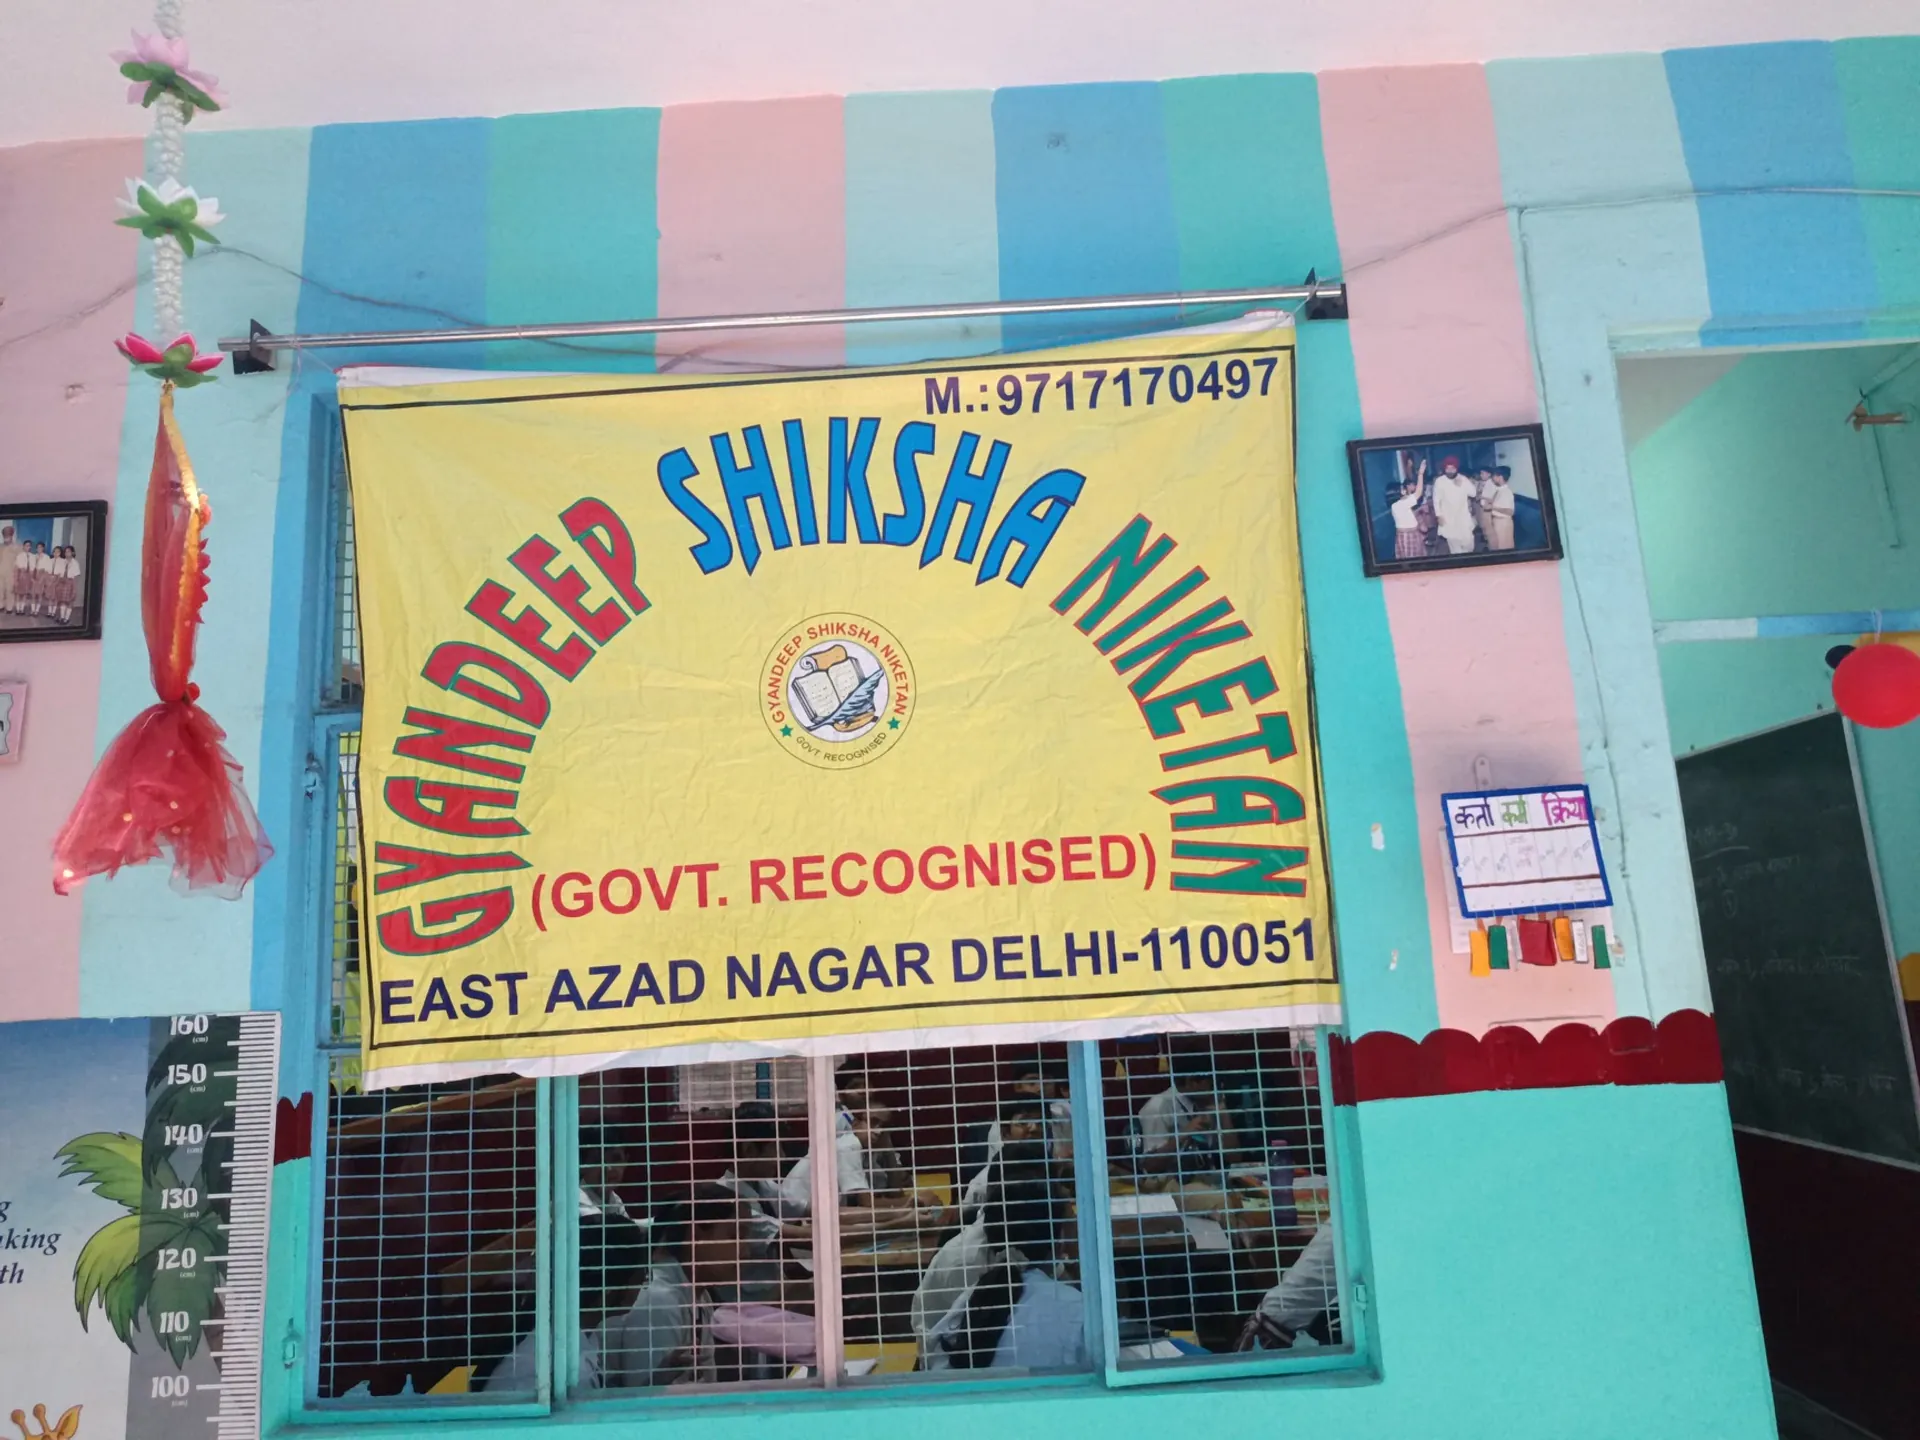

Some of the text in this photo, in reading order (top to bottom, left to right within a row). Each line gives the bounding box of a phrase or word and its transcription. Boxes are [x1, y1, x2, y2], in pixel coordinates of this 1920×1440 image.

[925, 356, 1280, 416] M.:9717170497
[767, 622, 909, 724] GYANDEEP SHIKSHA NIKETAN
[374, 416, 1310, 957] GYANDEEP SHIKSHA NIKETAN
[823, 732, 887, 761] RECOGNISED
[532, 833, 1157, 932] (GOVT. RECOGNISED)
[380, 917, 1315, 1025] EAST AZAD NAGAR DELHI-110051
[170, 1014, 209, 1036] 160
[167, 1063, 207, 1085] 150
[164, 1123, 204, 1146] 140
[161, 1187, 198, 1210] 130
[157, 1247, 197, 1270] 120
[159, 1311, 189, 1334] 110
[151, 1375, 189, 1398] 100
